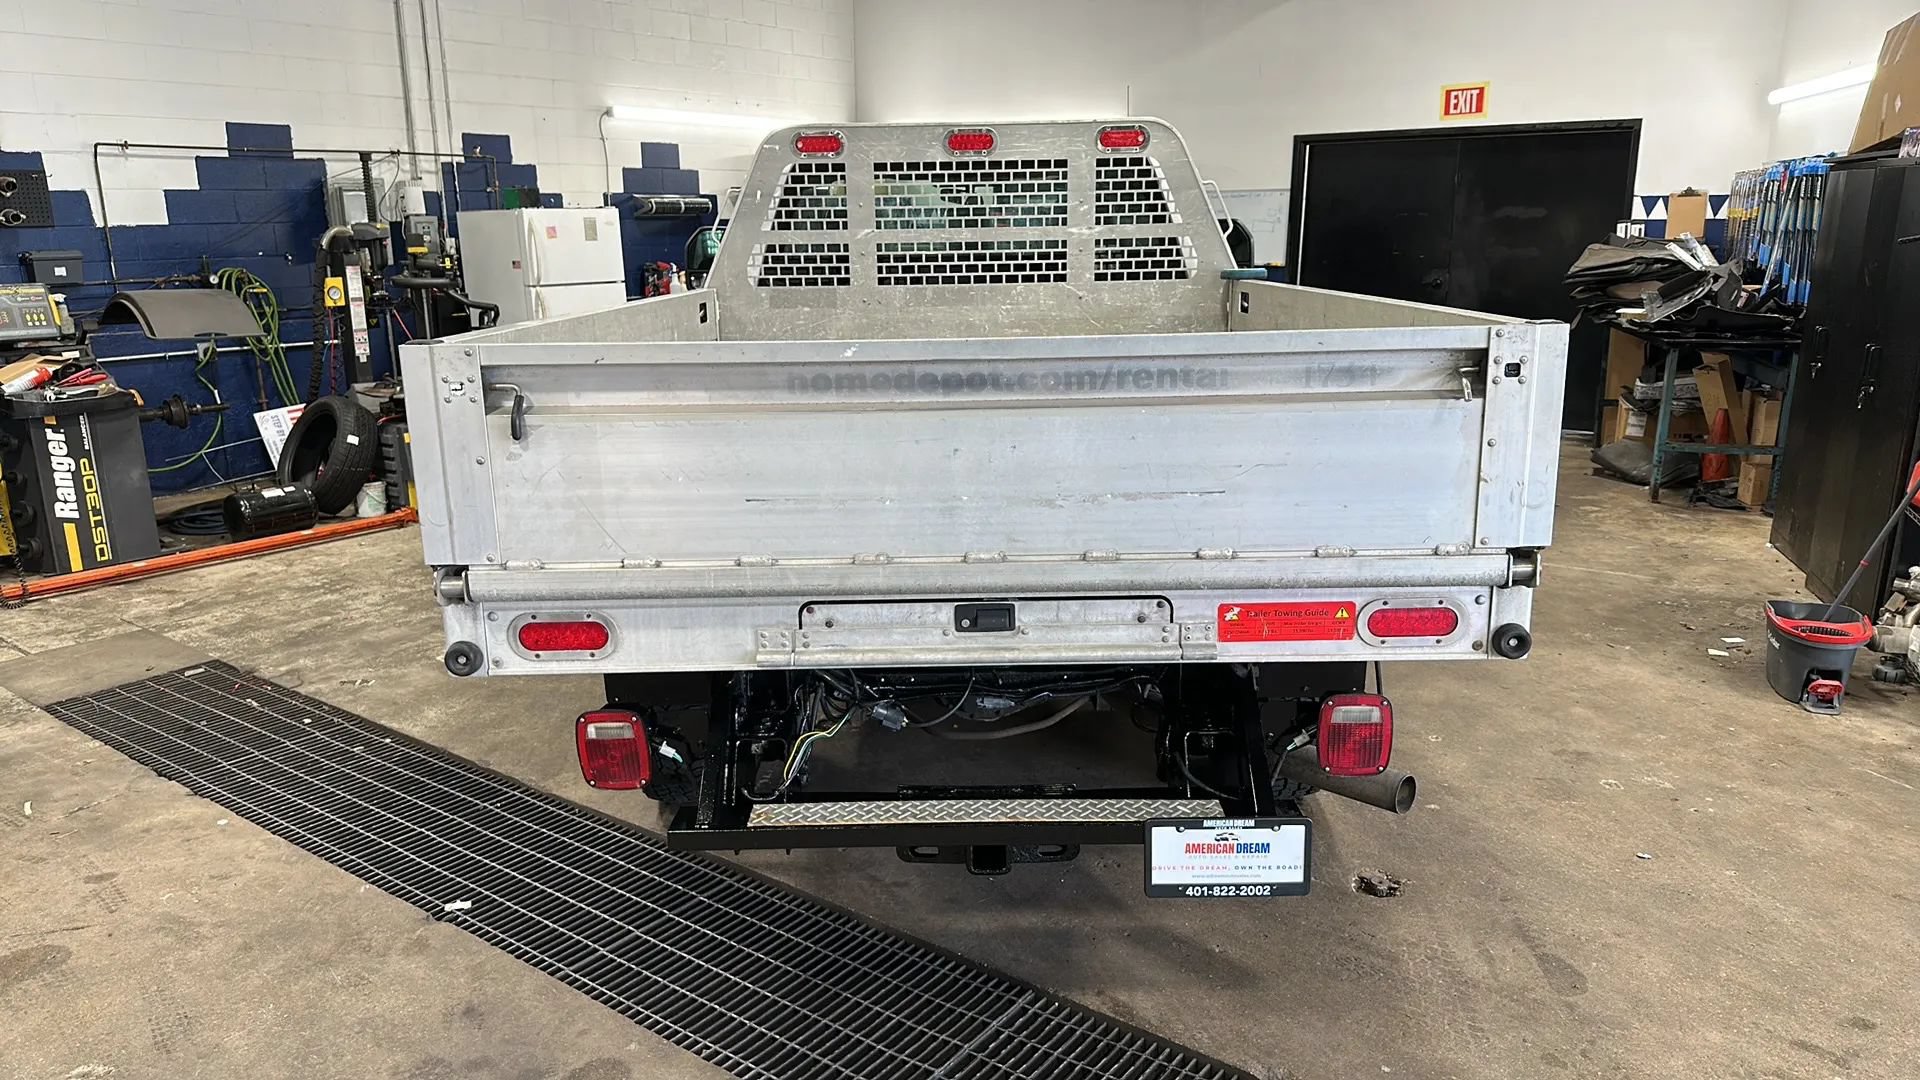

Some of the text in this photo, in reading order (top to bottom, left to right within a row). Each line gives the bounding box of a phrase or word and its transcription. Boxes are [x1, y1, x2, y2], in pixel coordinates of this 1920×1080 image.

[1449, 89, 1480, 114] EXIT
[79, 415, 90, 450] BALANCER
[45, 428, 80, 518] Ranger
[80, 457, 109, 562] DST30P
[1246, 608, 1329, 618] Trailer Towing Guide
[1234, 819, 1255, 827] DREAM
[1185, 843, 1270, 854] AMERICAN DREAM
[1185, 885, 1271, 896] 401-822-2002
